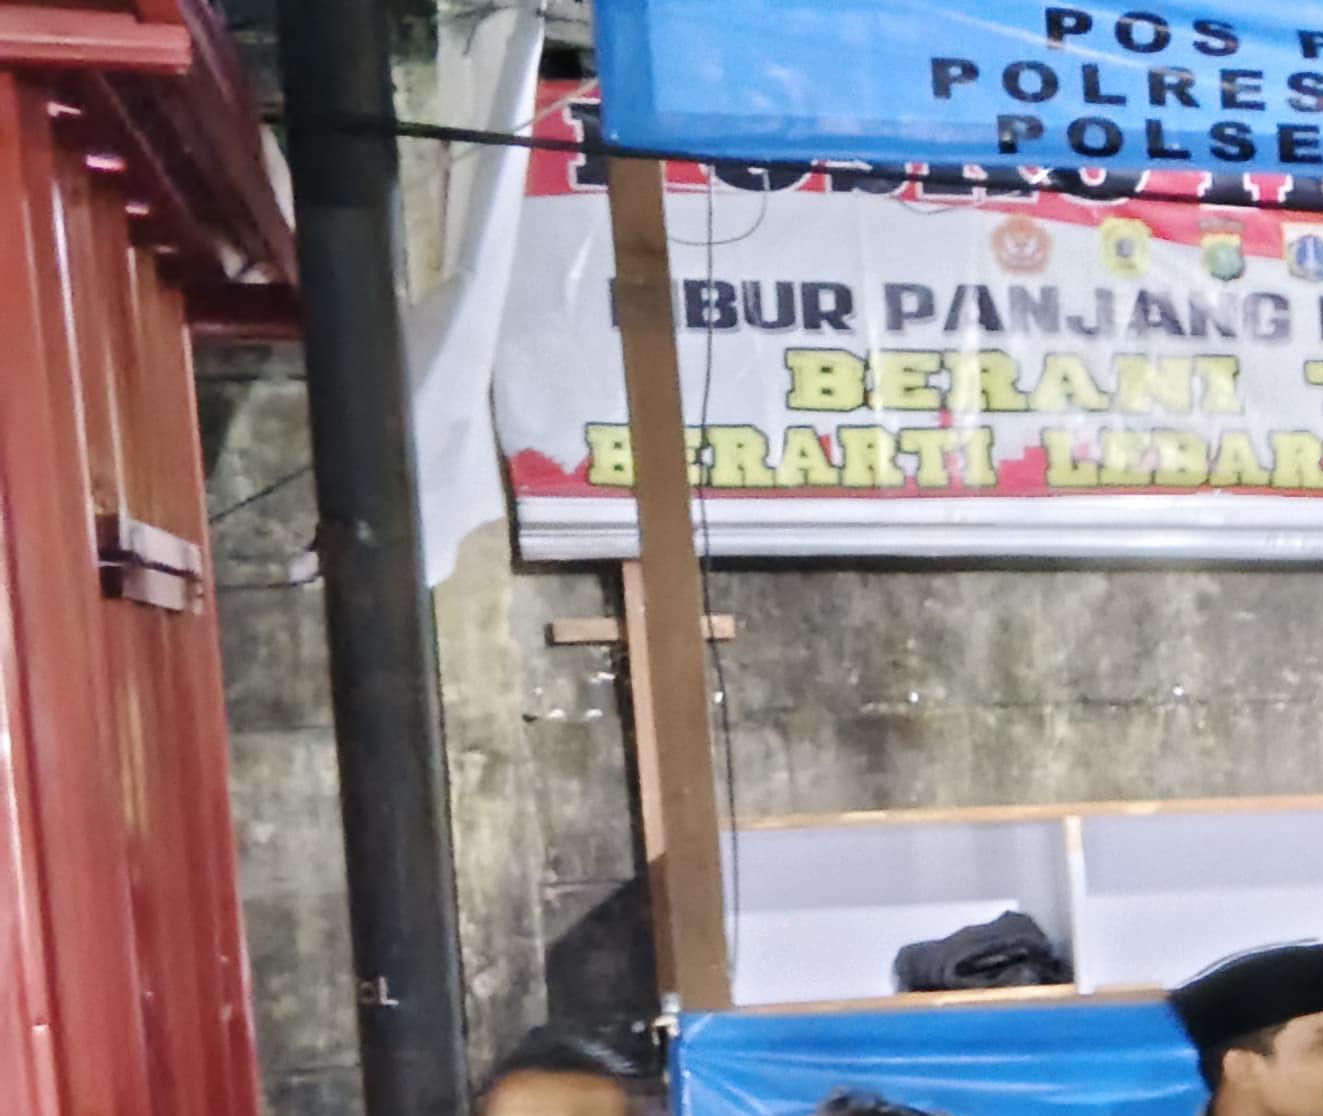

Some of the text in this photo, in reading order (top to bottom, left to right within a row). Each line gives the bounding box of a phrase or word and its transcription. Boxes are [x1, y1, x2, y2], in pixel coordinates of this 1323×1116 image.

[1044, 8, 1240, 56] POS
[610, 278, 854, 330] BUR
[883, 284, 1290, 340] PANJANG
[785, 347, 1242, 413] BERANI
